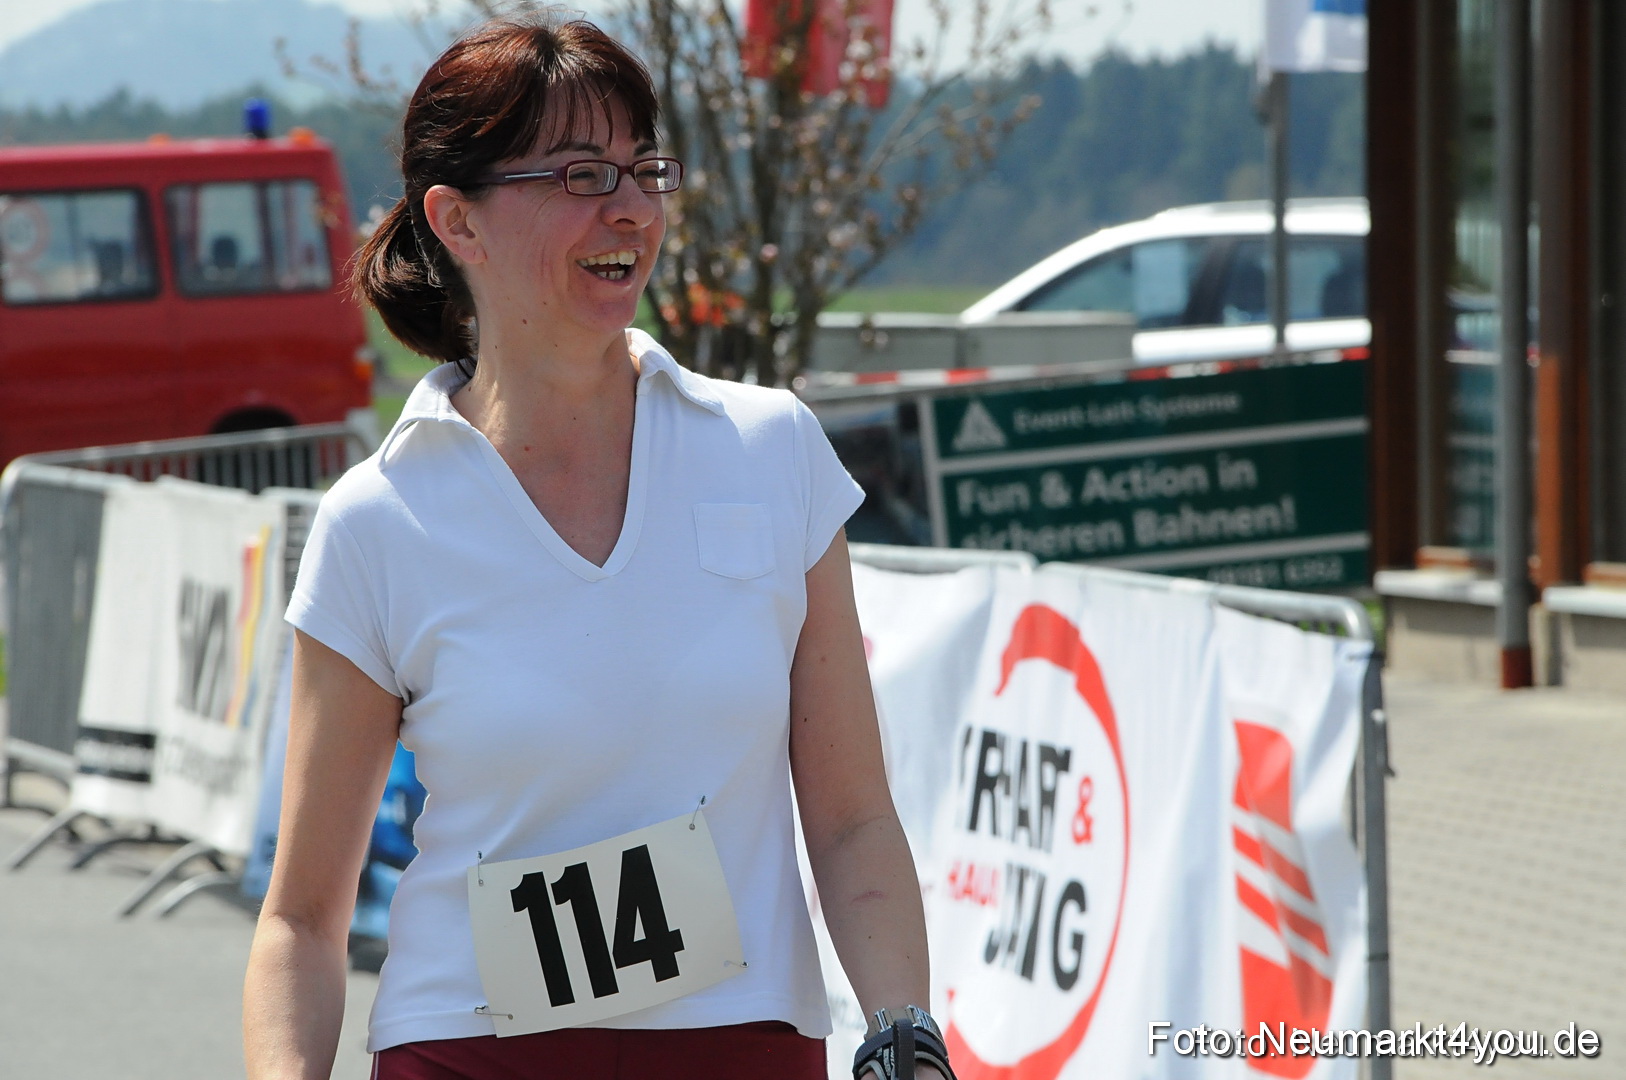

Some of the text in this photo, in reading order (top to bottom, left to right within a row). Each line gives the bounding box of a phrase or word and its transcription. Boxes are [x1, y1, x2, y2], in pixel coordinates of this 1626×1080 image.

[957, 451, 1257, 517] Fun & Action in
[1133, 493, 1297, 546] Bahnen!
[510, 844, 685, 1007] 114
